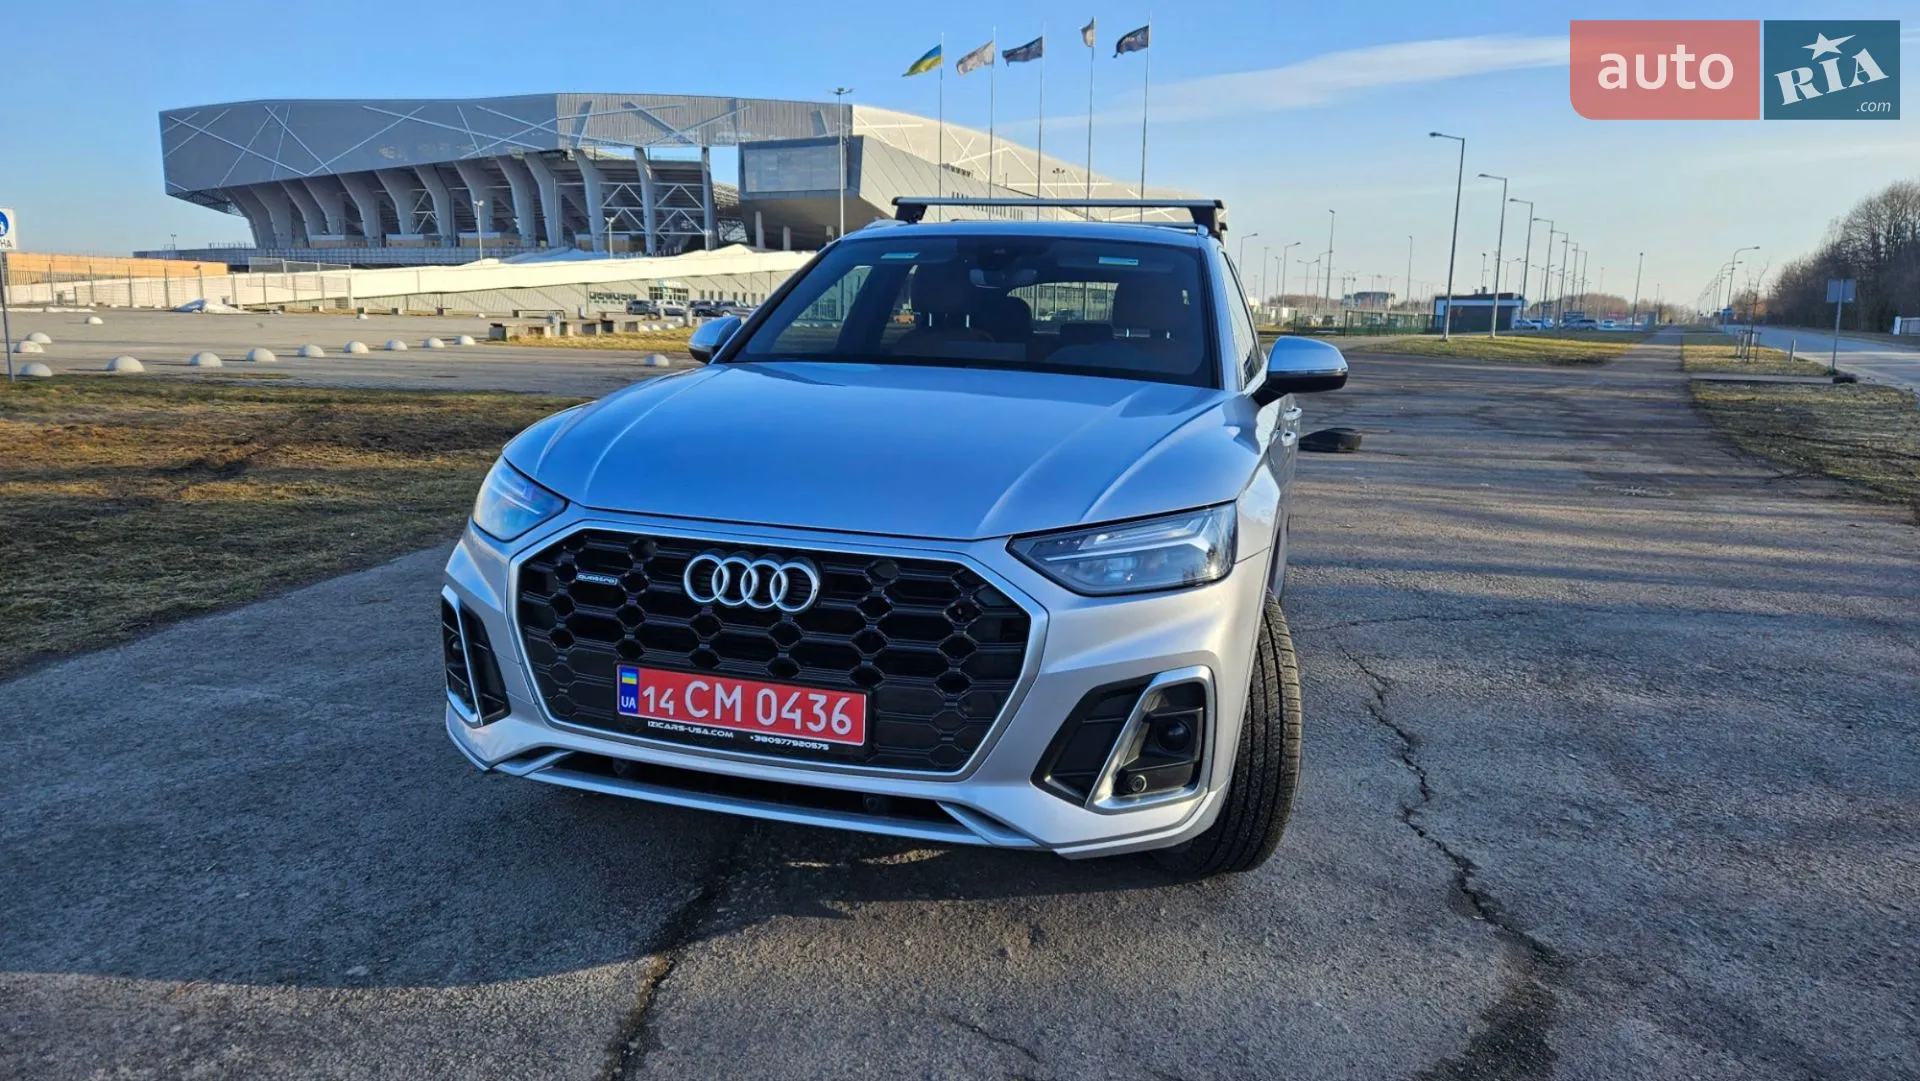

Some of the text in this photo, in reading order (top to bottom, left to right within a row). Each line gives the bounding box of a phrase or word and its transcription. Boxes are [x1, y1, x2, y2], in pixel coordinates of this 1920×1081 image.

[621, 695, 637, 710] UA
[642, 680, 852, 736] 14 CM 0436
